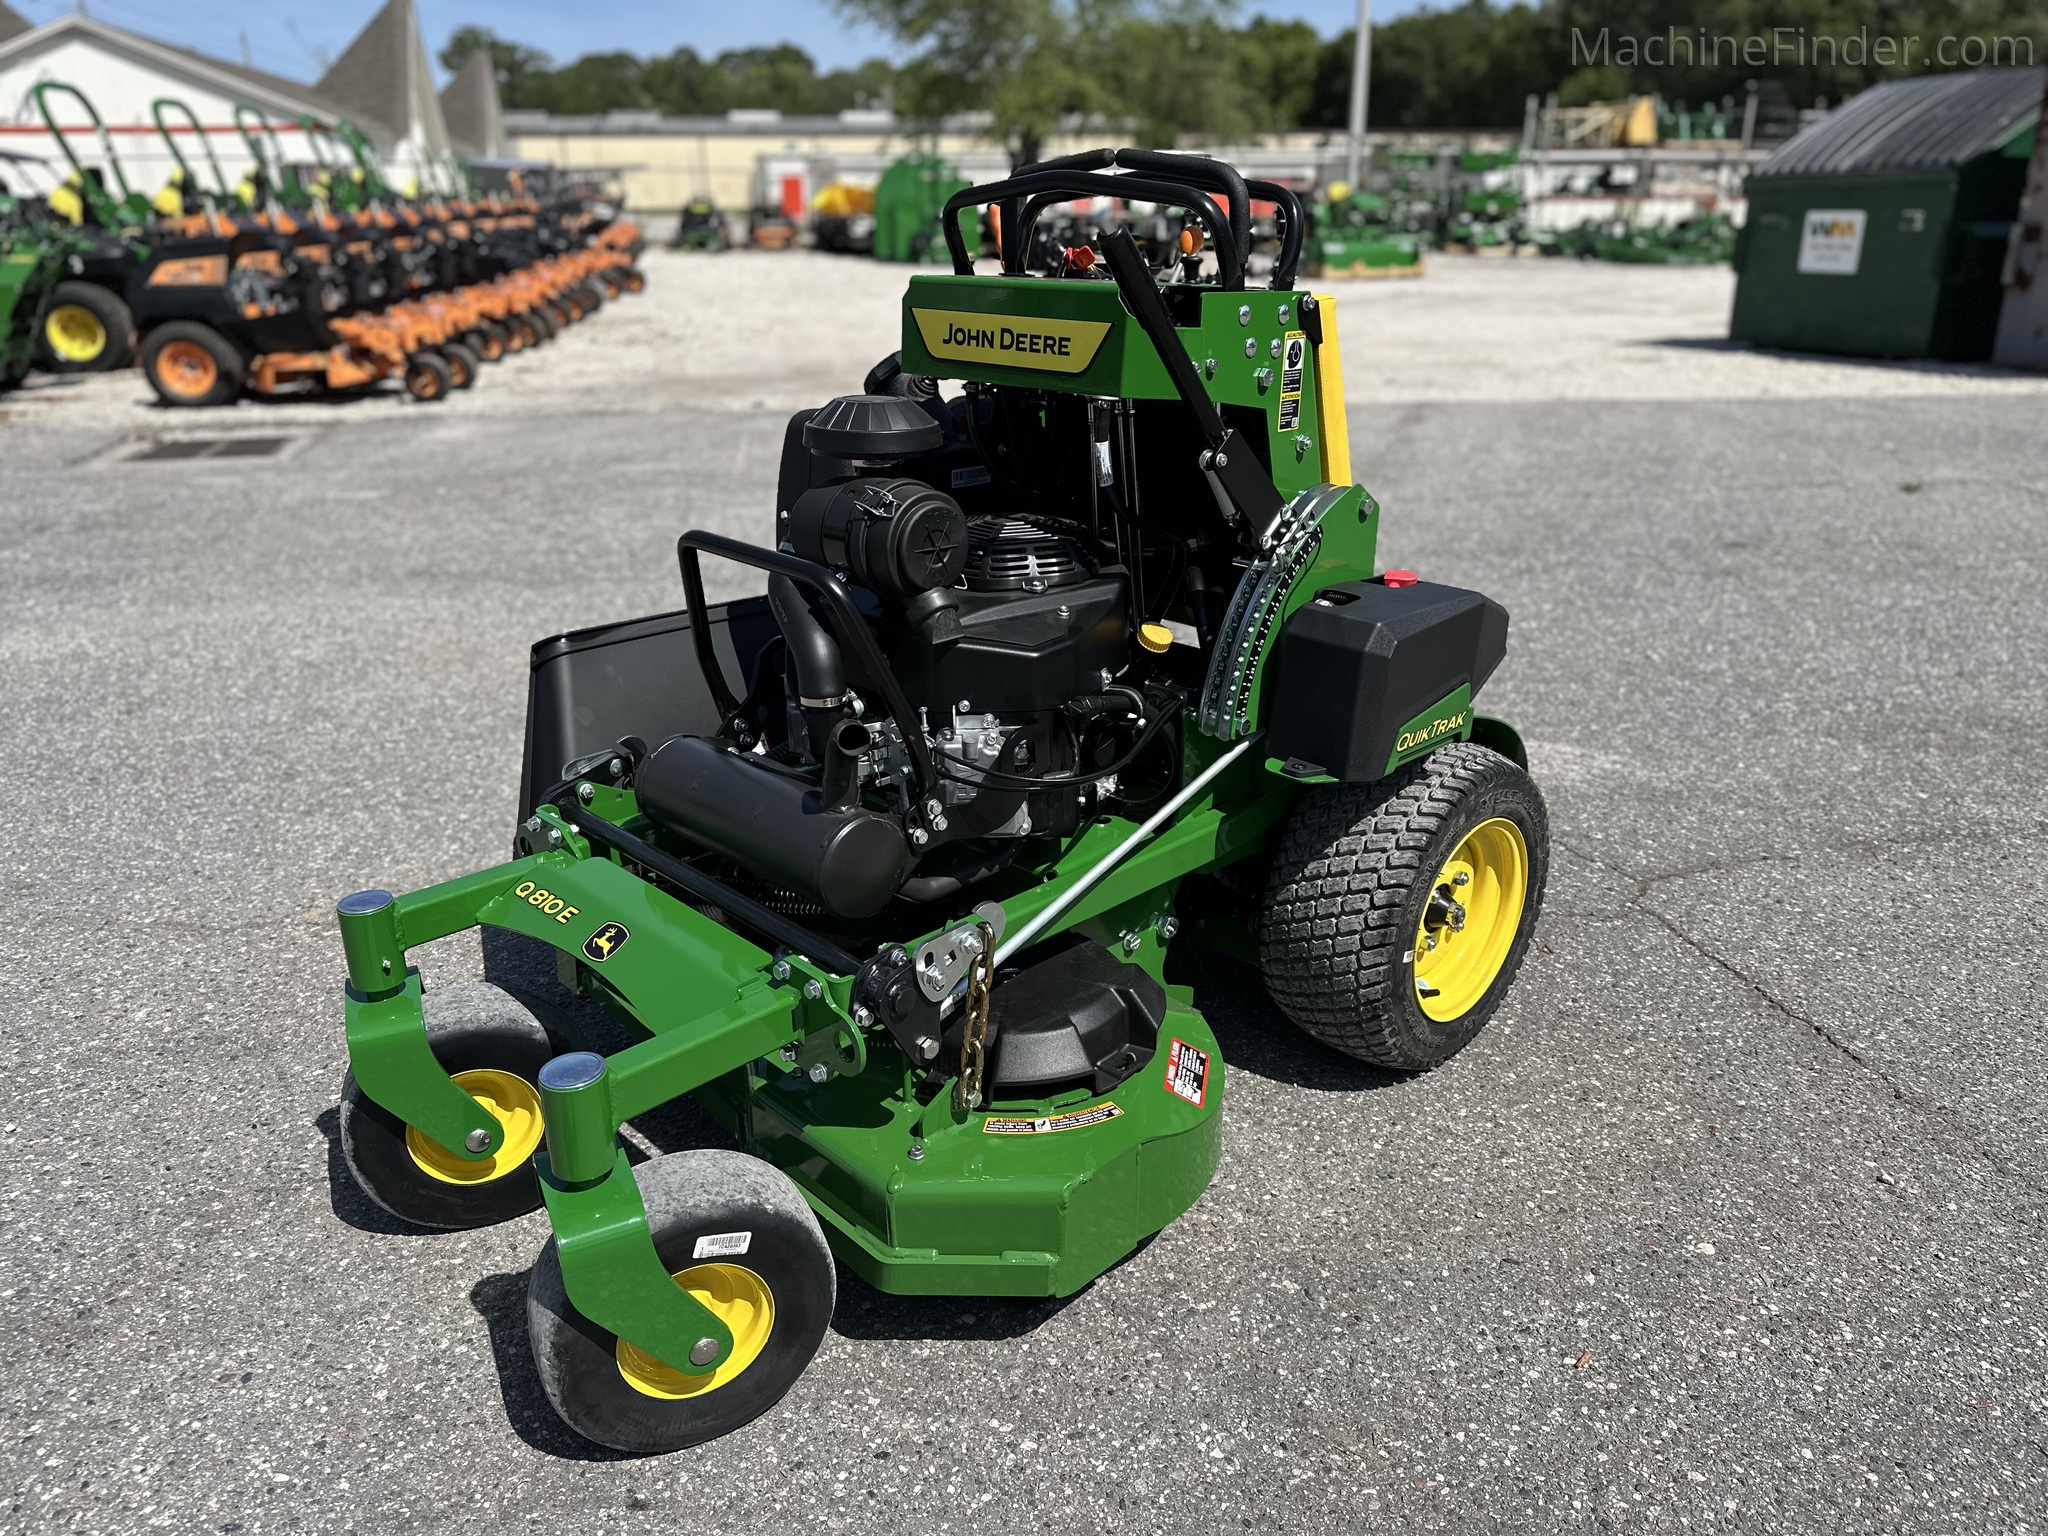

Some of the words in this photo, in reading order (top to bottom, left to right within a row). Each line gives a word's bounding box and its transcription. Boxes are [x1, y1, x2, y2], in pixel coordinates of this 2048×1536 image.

[942, 323, 995, 349] JOHN
[1000, 328, 1072, 357] DEERE
[514, 880, 581, 925] Q810E
